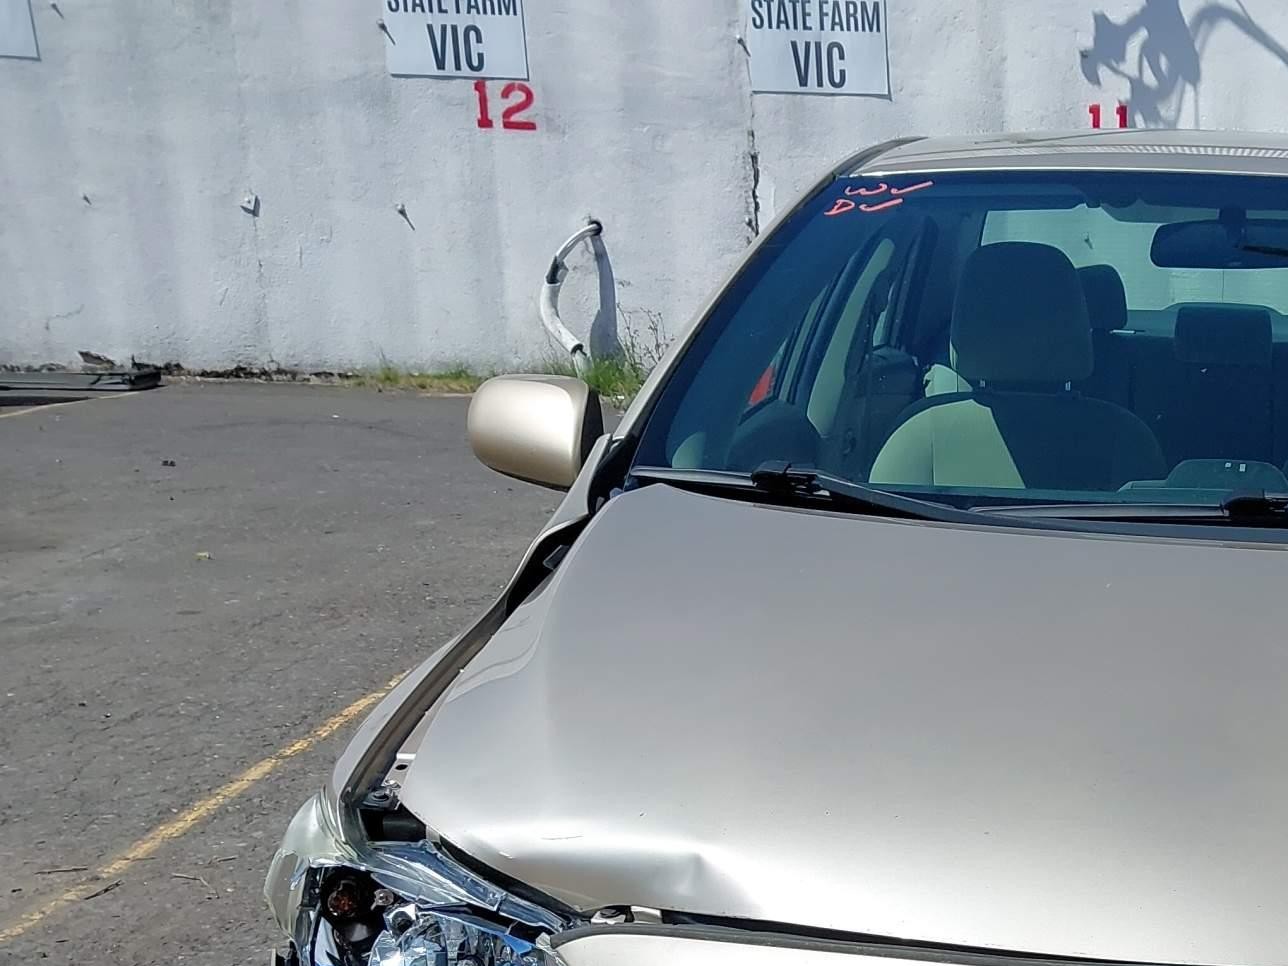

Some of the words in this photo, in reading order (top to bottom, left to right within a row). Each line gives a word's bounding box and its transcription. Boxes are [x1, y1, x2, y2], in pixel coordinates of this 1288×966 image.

[751, 0, 813, 31] STATE
[819, 0, 881, 33] FARM
[426, 23, 485, 72] VIC
[790, 40, 847, 88] VIC
[474, 79, 537, 130] 12
[1088, 103, 1128, 129] 11
